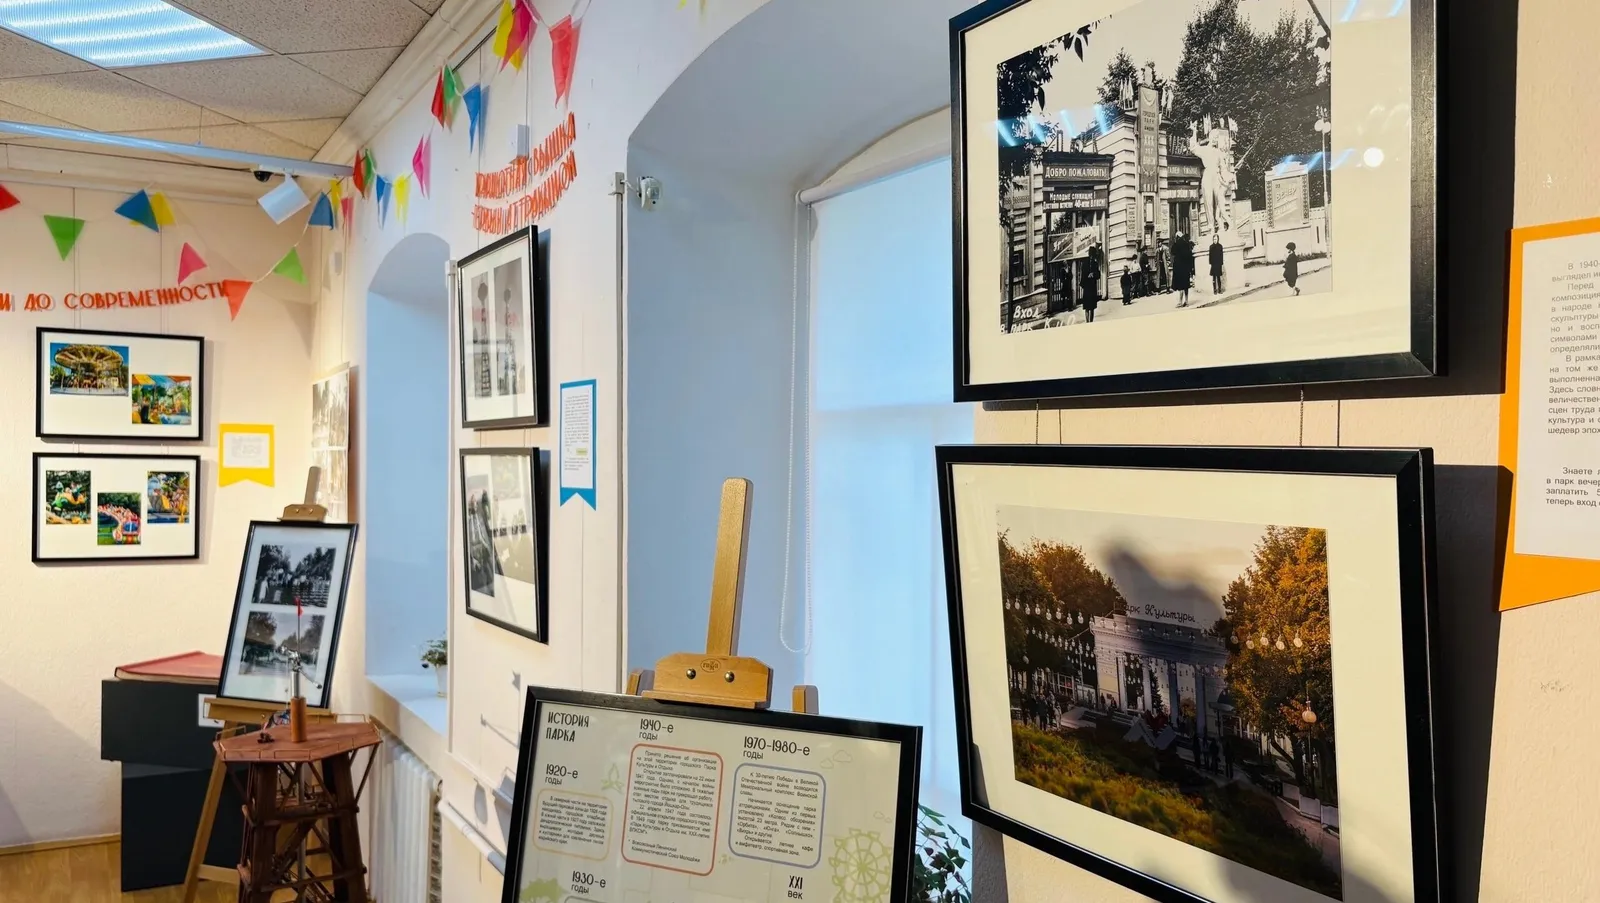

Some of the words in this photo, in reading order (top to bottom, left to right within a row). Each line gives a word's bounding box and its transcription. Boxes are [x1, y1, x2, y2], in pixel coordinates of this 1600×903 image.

[533, 112, 576, 176] ВЫШКА
[1045, 166, 1067, 178] ДОБРО
[1567, 262, 1574, 270] В
[1552, 272, 1591, 283] выглядел
[1567, 282, 1594, 291] Перед
[24, 294, 50, 311] ДО
[64, 282, 224, 309] СОВРЕМЕННОСТИ
[1562, 303, 1592, 312] народе
[1550, 313, 1599, 323] скульптуры
[1550, 334, 1597, 343] символами
[1549, 385, 1574, 394] Здесь
[1571, 406, 1595, 415] труда
[1548, 417, 1585, 425] культура
[1548, 427, 1580, 435] шедевр
[1562, 467, 1593, 475] Знаете
[1554, 478, 1575, 486] парк
[1546, 488, 1589, 496] заплатить
[1545, 498, 1574, 507] теперь
[1577, 499, 1597, 507] вход
[1145, 604, 1196, 623] Культуры
[547, 711, 590, 727] ИСТОРИЯ
[640, 718, 674, 733] 1940-е
[545, 727, 576, 742] ПАРКА
[639, 731, 658, 741] годы
[743, 736, 810, 756] 1970-1980-е
[743, 750, 764, 760] годы
[546, 763, 579, 779] 1920-е
[544, 776, 562, 786] годы
[572, 870, 606, 889] 1930-е
[788, 875, 803, 890] XXI
[571, 884, 590, 894] годы
[787, 890, 803, 900] век
